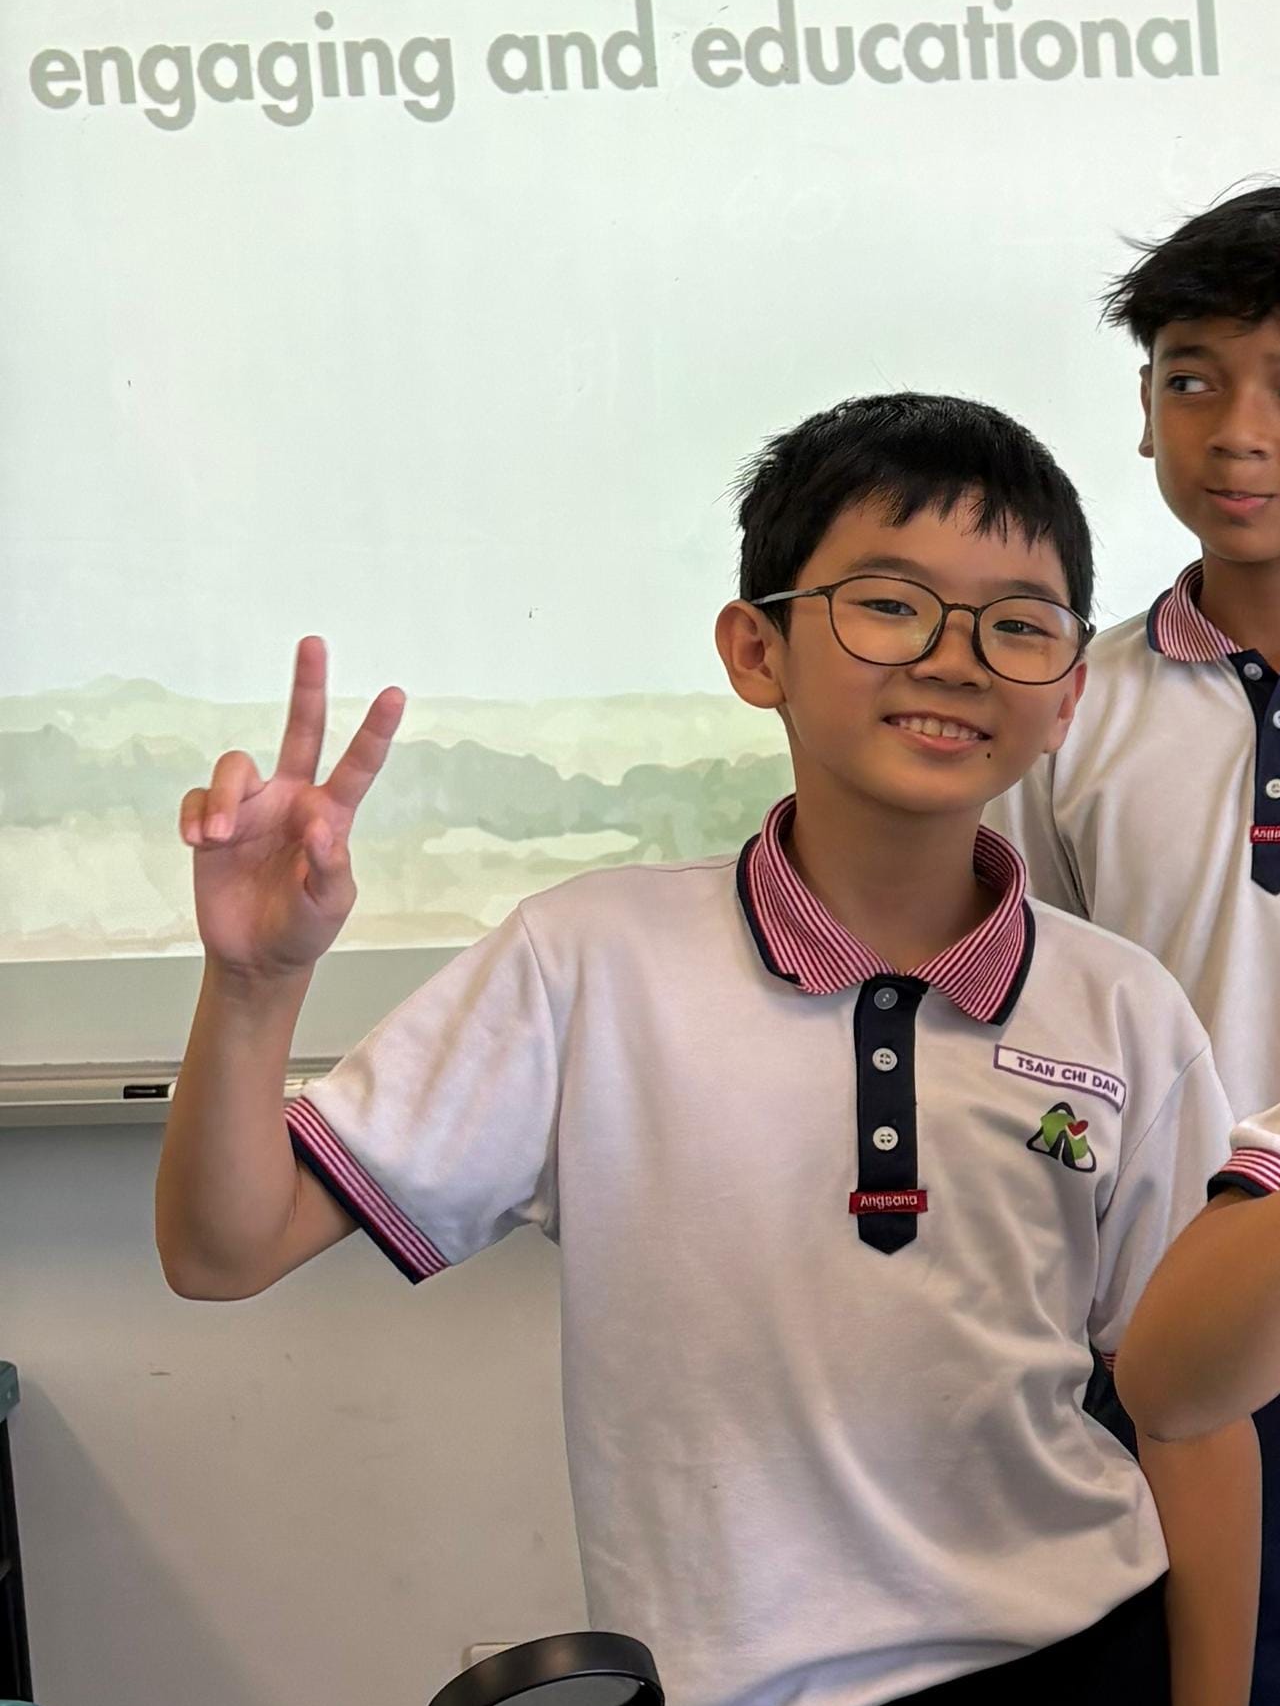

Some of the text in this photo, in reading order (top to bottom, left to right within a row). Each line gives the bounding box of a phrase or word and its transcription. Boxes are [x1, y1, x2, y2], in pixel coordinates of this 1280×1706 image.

[29, 10, 455, 131] engaging
[1017, 1056, 1118, 1096] TSAN CHI DAN
[860, 1195, 917, 1209] Angsana
